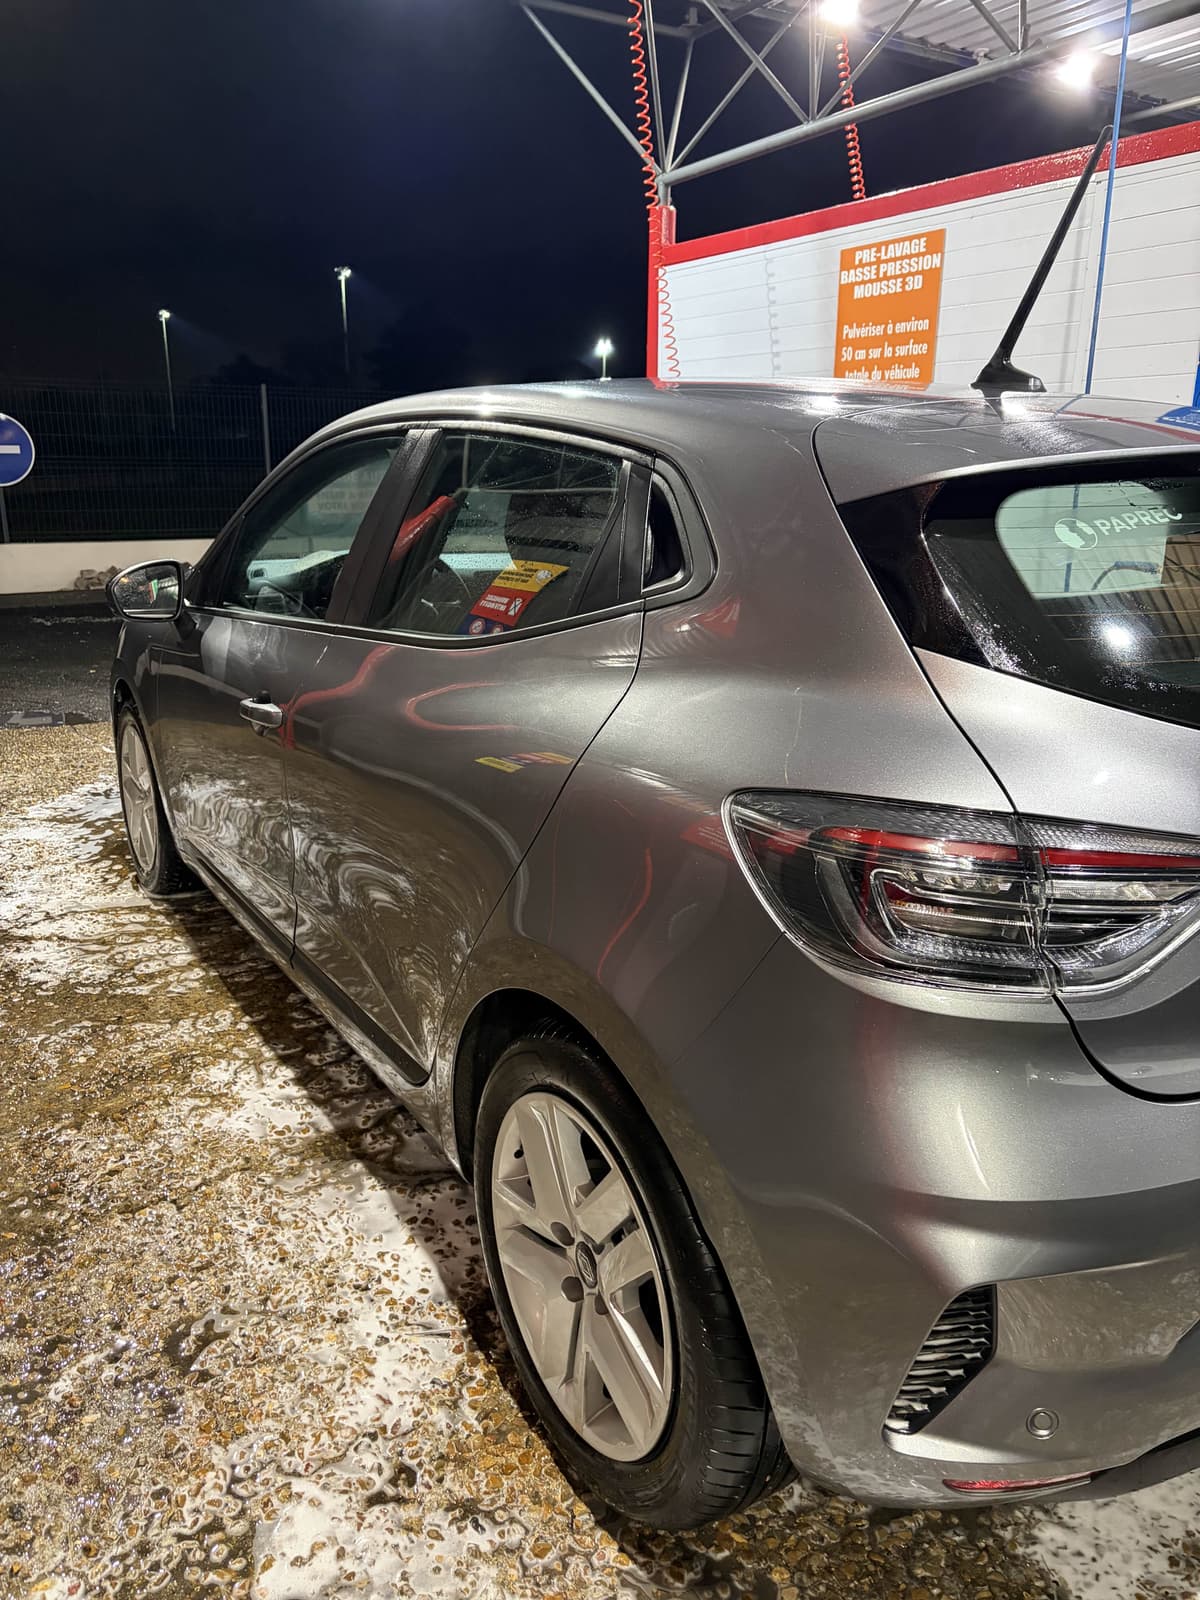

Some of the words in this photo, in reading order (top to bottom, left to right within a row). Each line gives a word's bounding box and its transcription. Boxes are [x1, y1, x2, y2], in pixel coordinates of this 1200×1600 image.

[855, 237, 927, 265] PRE-LAVAGE
[840, 265, 877, 285] BASSE
[879, 252, 942, 278] PRESSION
[854, 277, 903, 299] MOUSSE
[905, 275, 923, 292] 3D
[842, 322, 884, 340] Pulvériser
[887, 320, 894, 335] à
[895, 316, 929, 334] environ
[841, 347, 853, 362] 50
[855, 349, 866, 361] cm
[868, 347, 881, 359] sur
[884, 342, 892, 357] la
[895, 339, 928, 356] surface
[871, 365, 882, 380] du
[885, 363, 920, 380] véhicule
